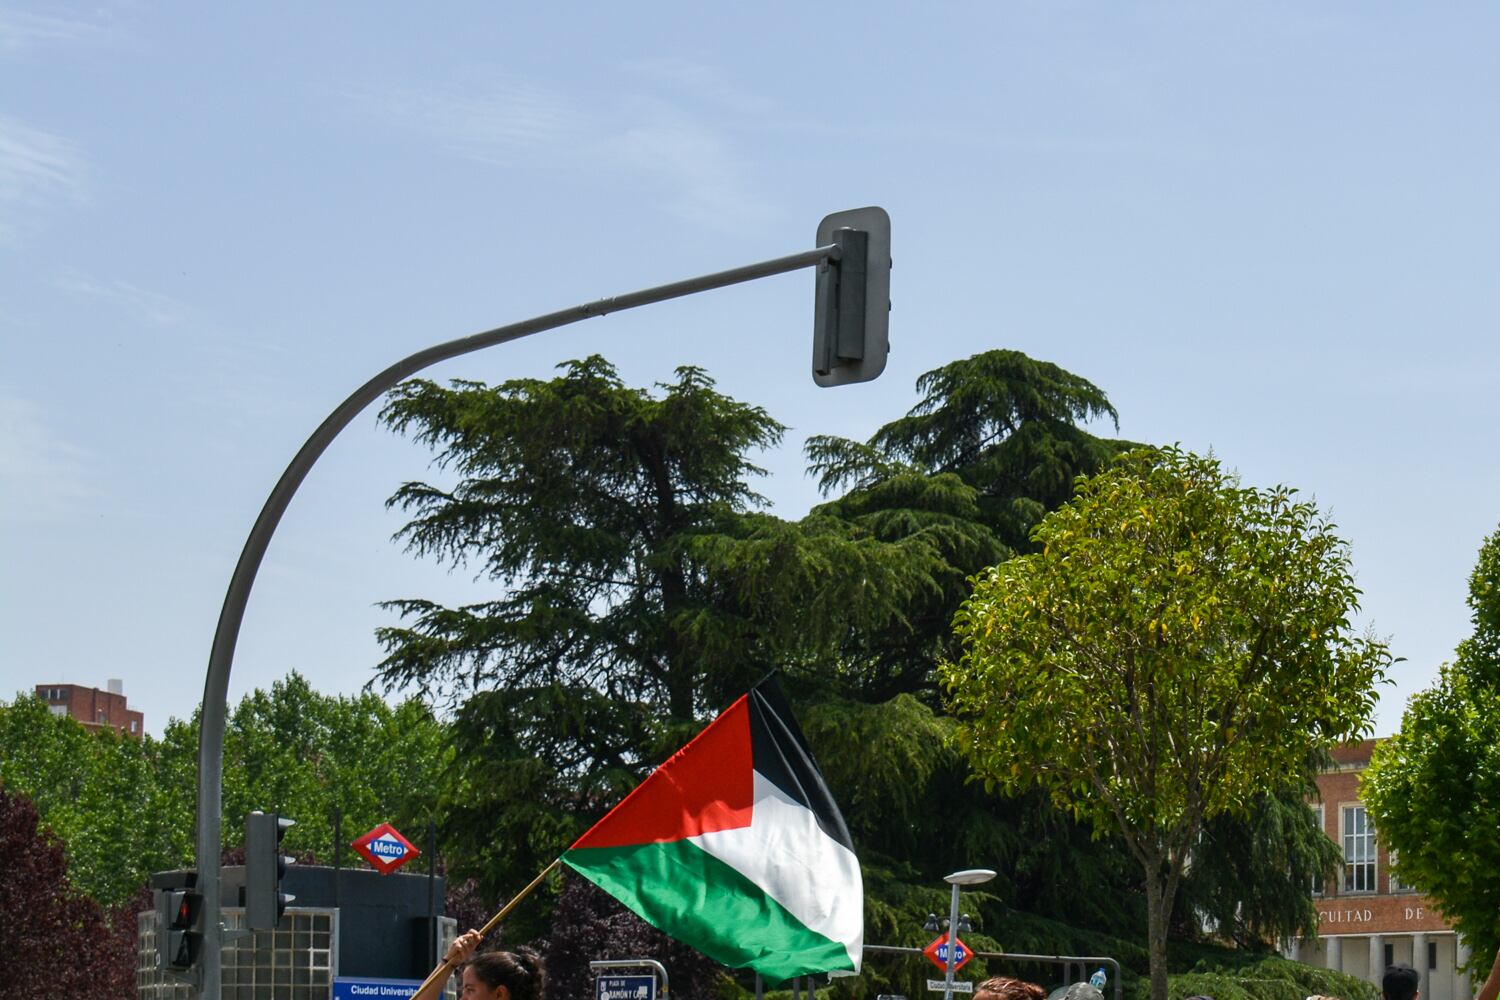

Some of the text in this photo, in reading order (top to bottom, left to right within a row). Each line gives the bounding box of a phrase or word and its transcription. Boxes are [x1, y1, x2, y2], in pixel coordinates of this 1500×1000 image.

[374, 841, 403, 855] Metro
[1319, 907, 1424, 923] CULTAD DE
[940, 948, 963, 959] Mro
[351, 985, 378, 995] Ciudad
